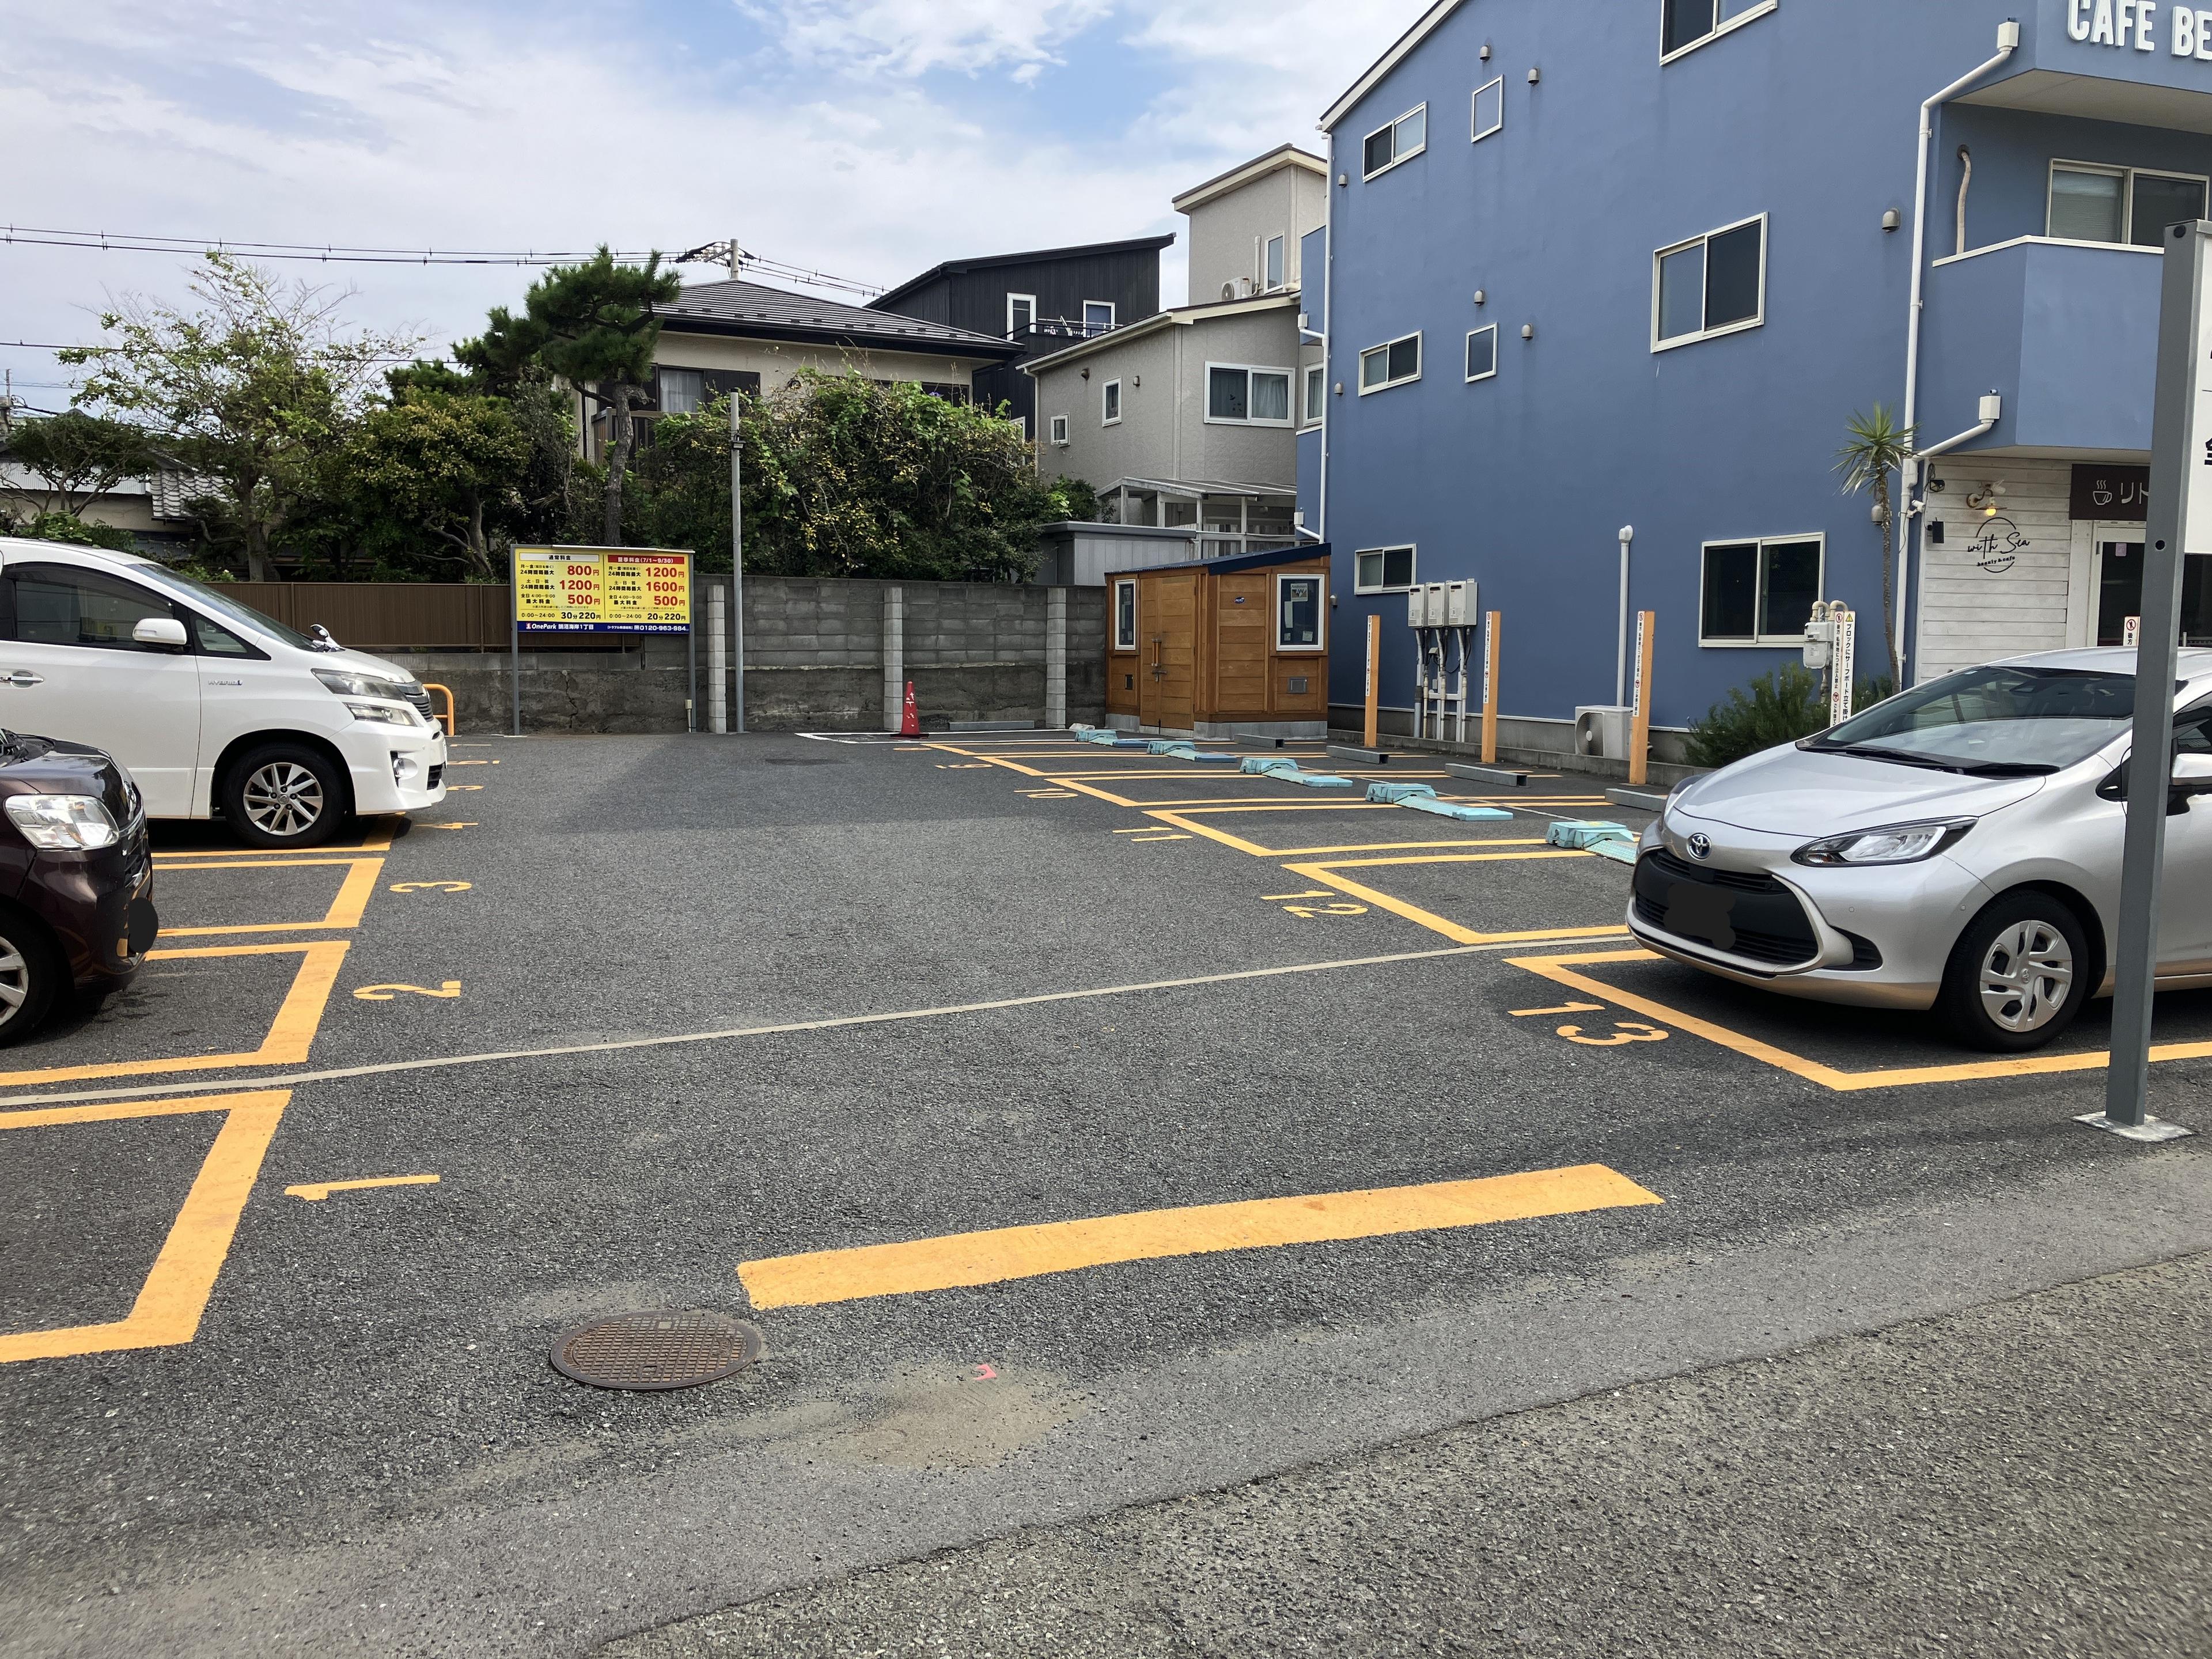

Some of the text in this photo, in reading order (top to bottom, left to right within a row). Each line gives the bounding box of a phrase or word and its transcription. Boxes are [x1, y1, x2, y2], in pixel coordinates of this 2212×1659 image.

[2068, 0, 2212, 60] CAFE BE
[1967, 532, 2030, 559] with Sea
[567, 565, 599, 576] 800円
[646, 567, 684, 578] 1200円
[559, 580, 600, 590] 1200円
[646, 581, 685, 592] 1600円
[567, 594, 600, 605] 500円
[654, 596, 685, 606] 500円
[1014, 788, 1078, 798] 10
[1112, 826, 1194, 842] 11
[389, 881, 472, 892] 3
[1260, 891, 1369, 918] 12
[353, 980, 461, 999] 2
[1507, 1002, 1669, 1046] 13
[284, 1175, 440, 1201] 1
